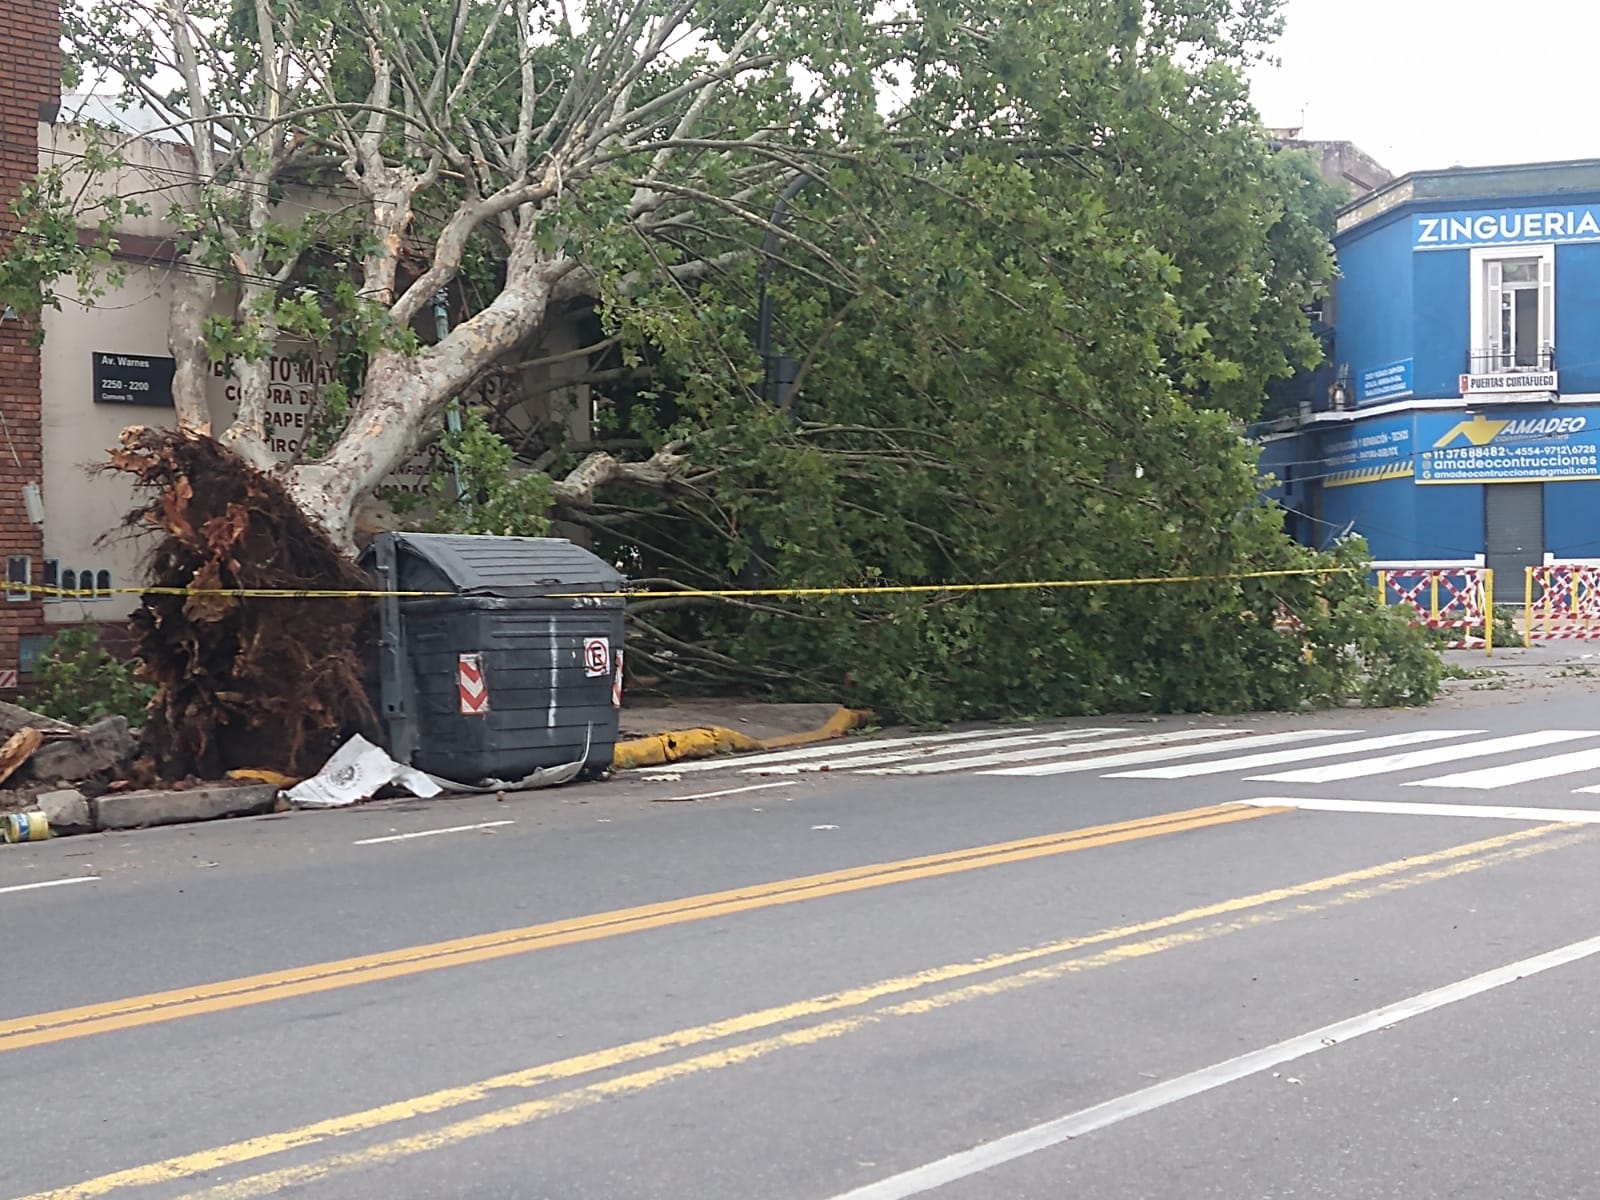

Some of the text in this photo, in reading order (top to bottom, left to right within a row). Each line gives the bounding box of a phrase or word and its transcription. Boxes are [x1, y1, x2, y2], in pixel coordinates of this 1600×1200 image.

[1418, 210, 1600, 243] ZINGUERIA
[101, 355, 150, 368] Av. Warnes
[101, 379, 122, 389] 2250
[128, 380, 150, 391] 2200
[1470, 375, 1554, 389] PUERTAS CORTAFUEGO
[1502, 416, 1587, 434] AMADEO
[1433, 454, 1597, 470] amadeocontrucciones
[1433, 466, 1598, 479] amadeocontrucciones@gmail.com
